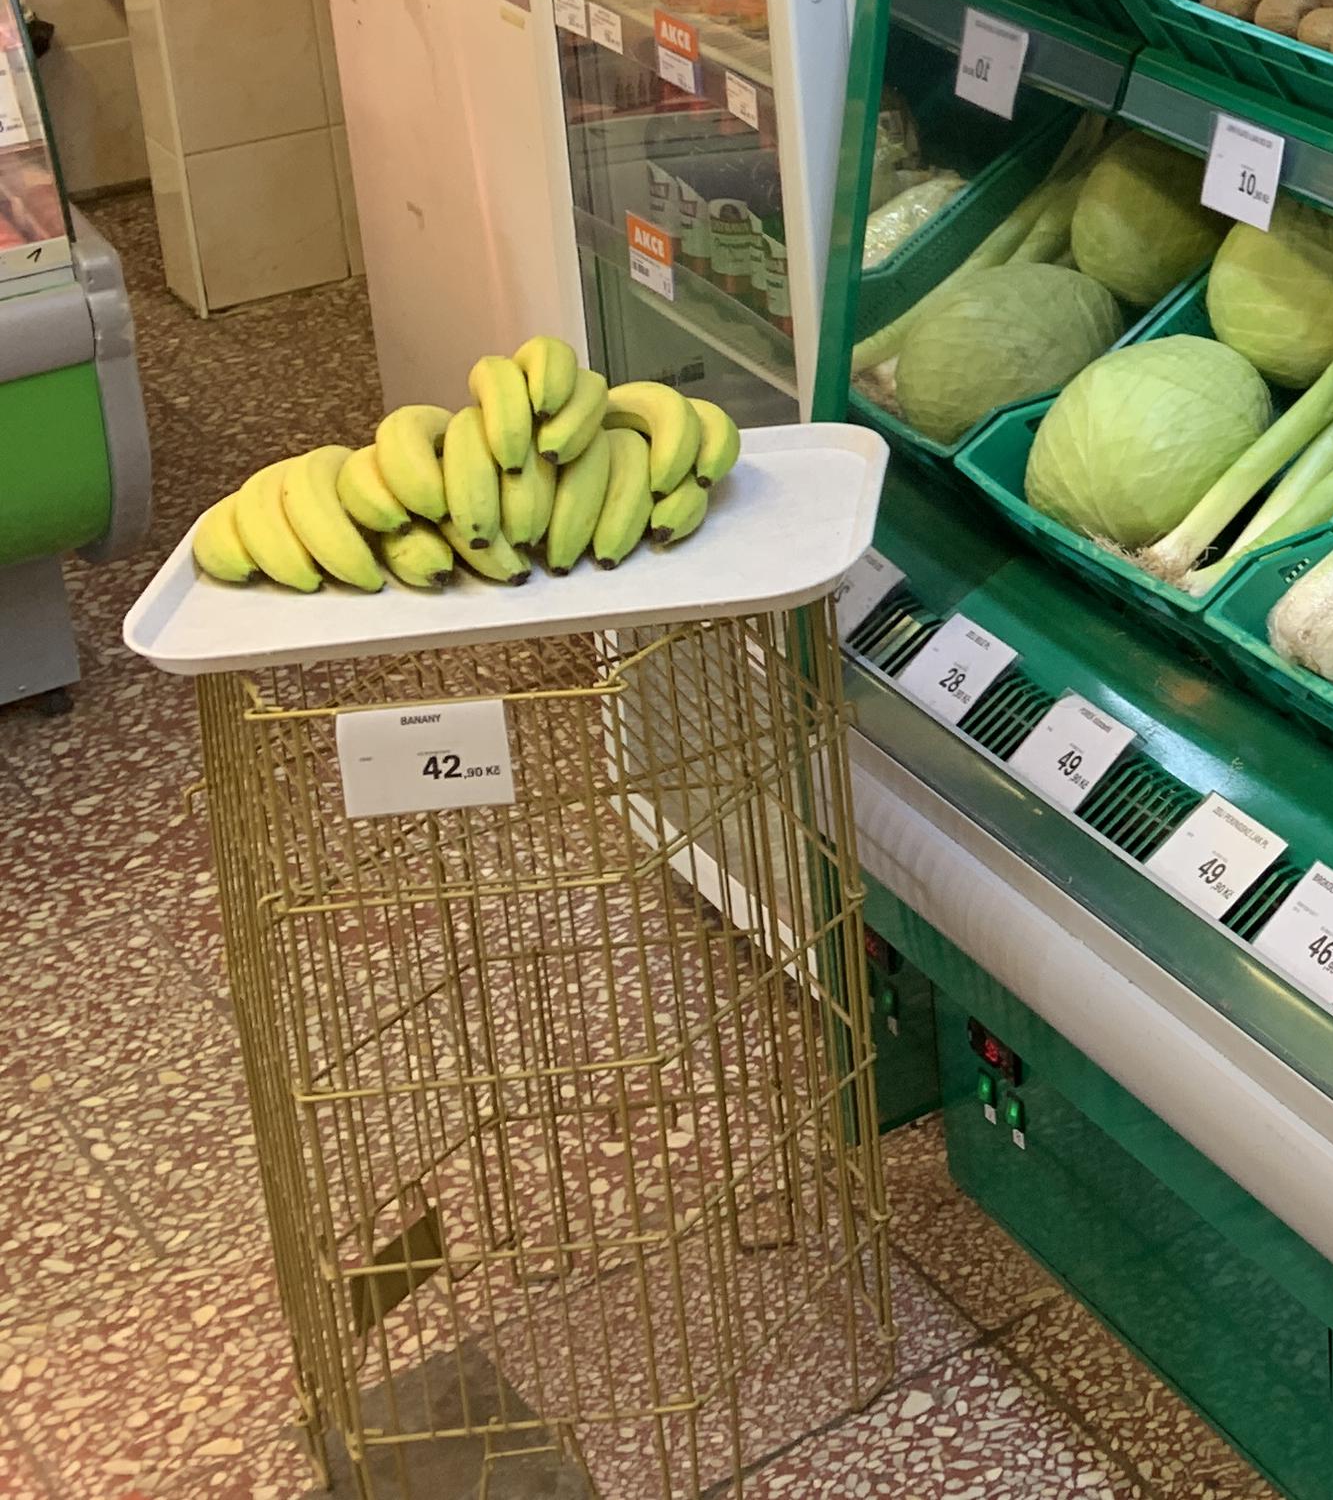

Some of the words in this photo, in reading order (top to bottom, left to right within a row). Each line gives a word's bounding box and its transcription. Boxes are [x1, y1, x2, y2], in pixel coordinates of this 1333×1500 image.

[659, 19, 692, 52] AKCE
[634, 226, 665, 258] AKCE
[400, 713, 441, 726] BANANY
[485, 764, 500, 777] Kč
